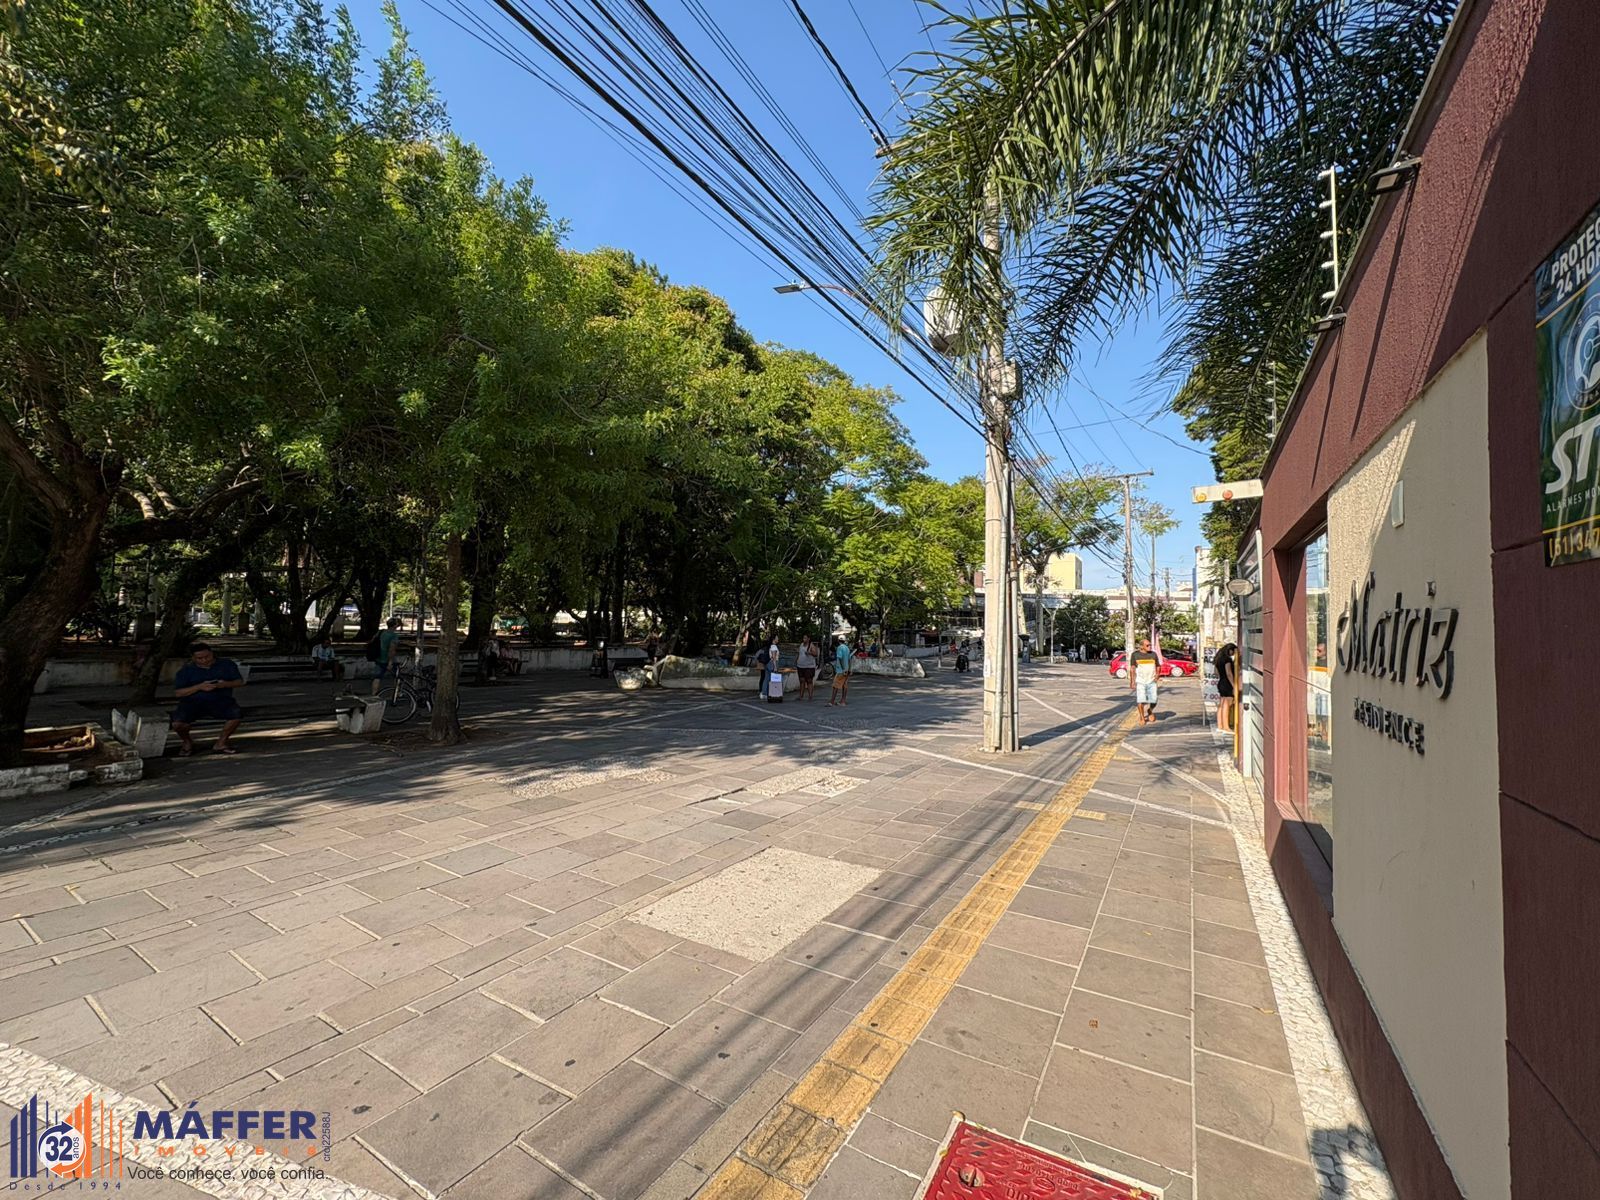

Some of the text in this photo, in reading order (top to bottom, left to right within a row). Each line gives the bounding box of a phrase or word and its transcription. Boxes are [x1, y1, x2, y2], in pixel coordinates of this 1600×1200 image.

[1556, 271, 1573, 302] 24
[1546, 493, 1582, 513] ALARMES
[1337, 571, 1459, 700] Matriz
